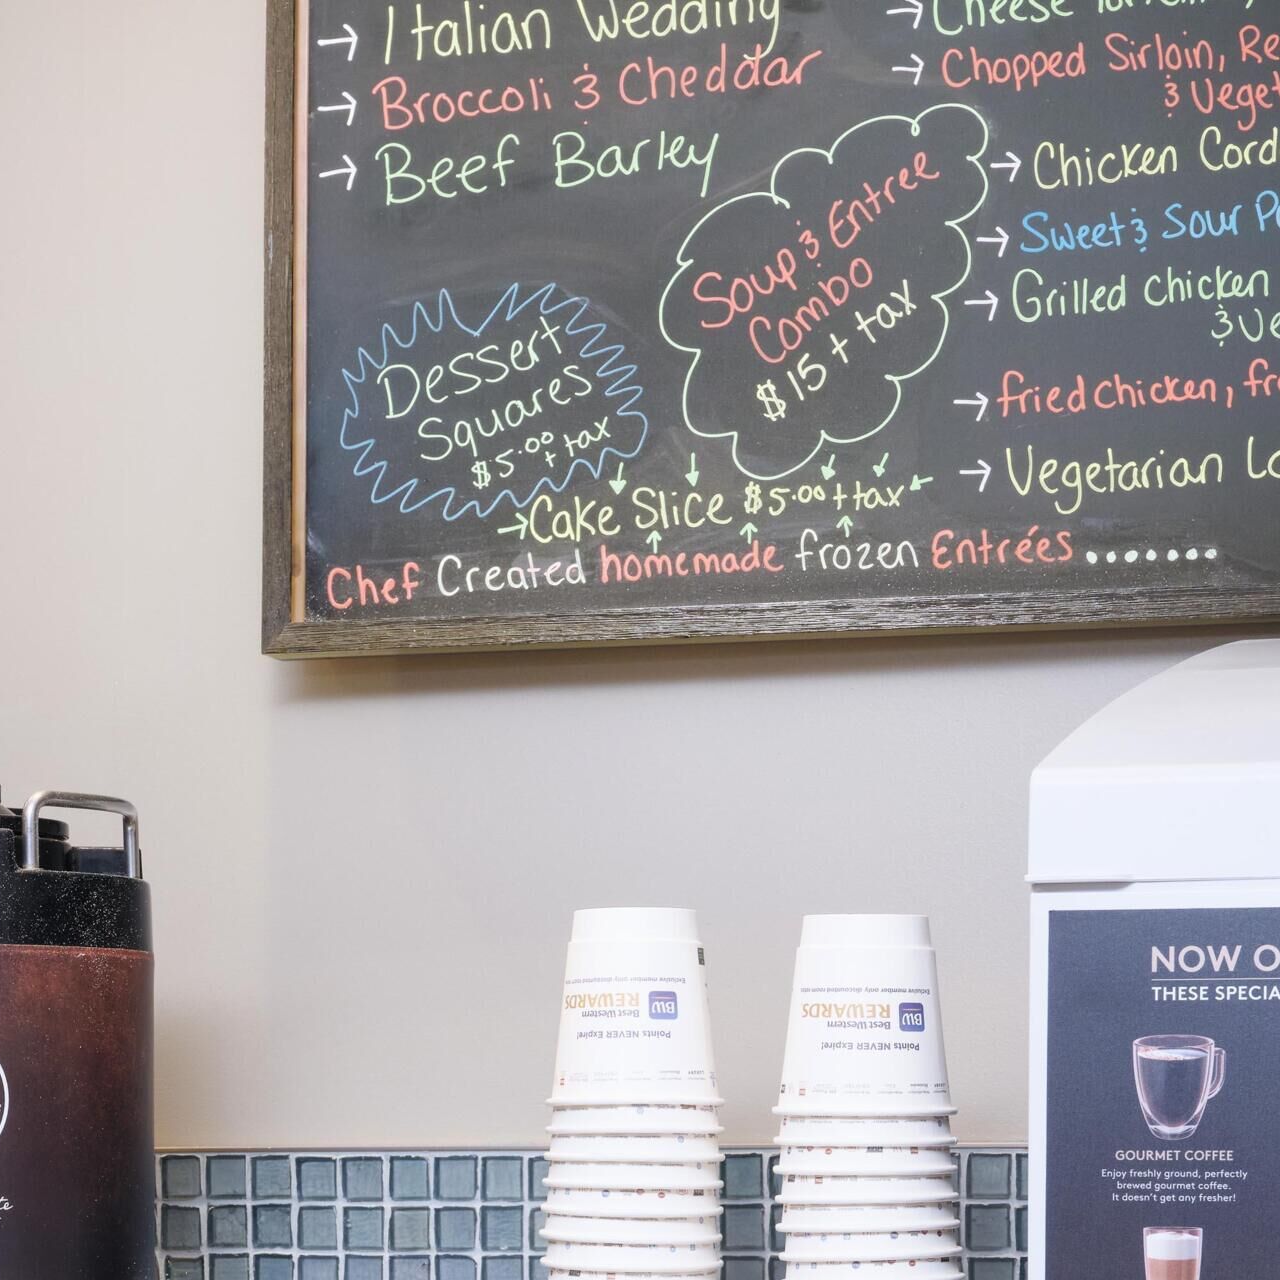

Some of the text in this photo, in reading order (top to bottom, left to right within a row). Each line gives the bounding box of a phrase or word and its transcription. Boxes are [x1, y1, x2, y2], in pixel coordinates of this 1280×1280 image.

[385, 0, 551, 64] Italian
[941, 43, 1086, 91] Chopped
[1105, 30, 1225, 73] Sirloin,
[373, 44, 824, 131] Broccoli Cheddar
[375, 131, 719, 205] Beef Barley
[1033, 129, 1179, 191] Chicken
[693, 150, 939, 328] Soup Entree
[1021, 209, 1121, 255] Sweet
[1162, 201, 1246, 241] Sour
[749, 257, 875, 366] Combo
[377, 317, 563, 420] Dessert
[756, 353, 828, 420] $15
[419, 364, 593, 461] Squares
[1006, 445, 1224, 515] Vegetarian
[528, 486, 725, 544] Cake Slice
[327, 525, 1075, 610] Chef Created homemade frozen Entrées
[1151, 946, 1241, 973] NOW
[802, 1003, 891, 1018] REWARDS
[827, 1019, 891, 1030] Best Western
[1152, 987, 1209, 1001] THESE
[821, 1041, 920, 1051] Points NEVER Expire!
[1101, 1168, 1248, 1180] Enjoy freshly ground, perfectly
[1115, 1150, 1234, 1161] GOURMET COFFEE
